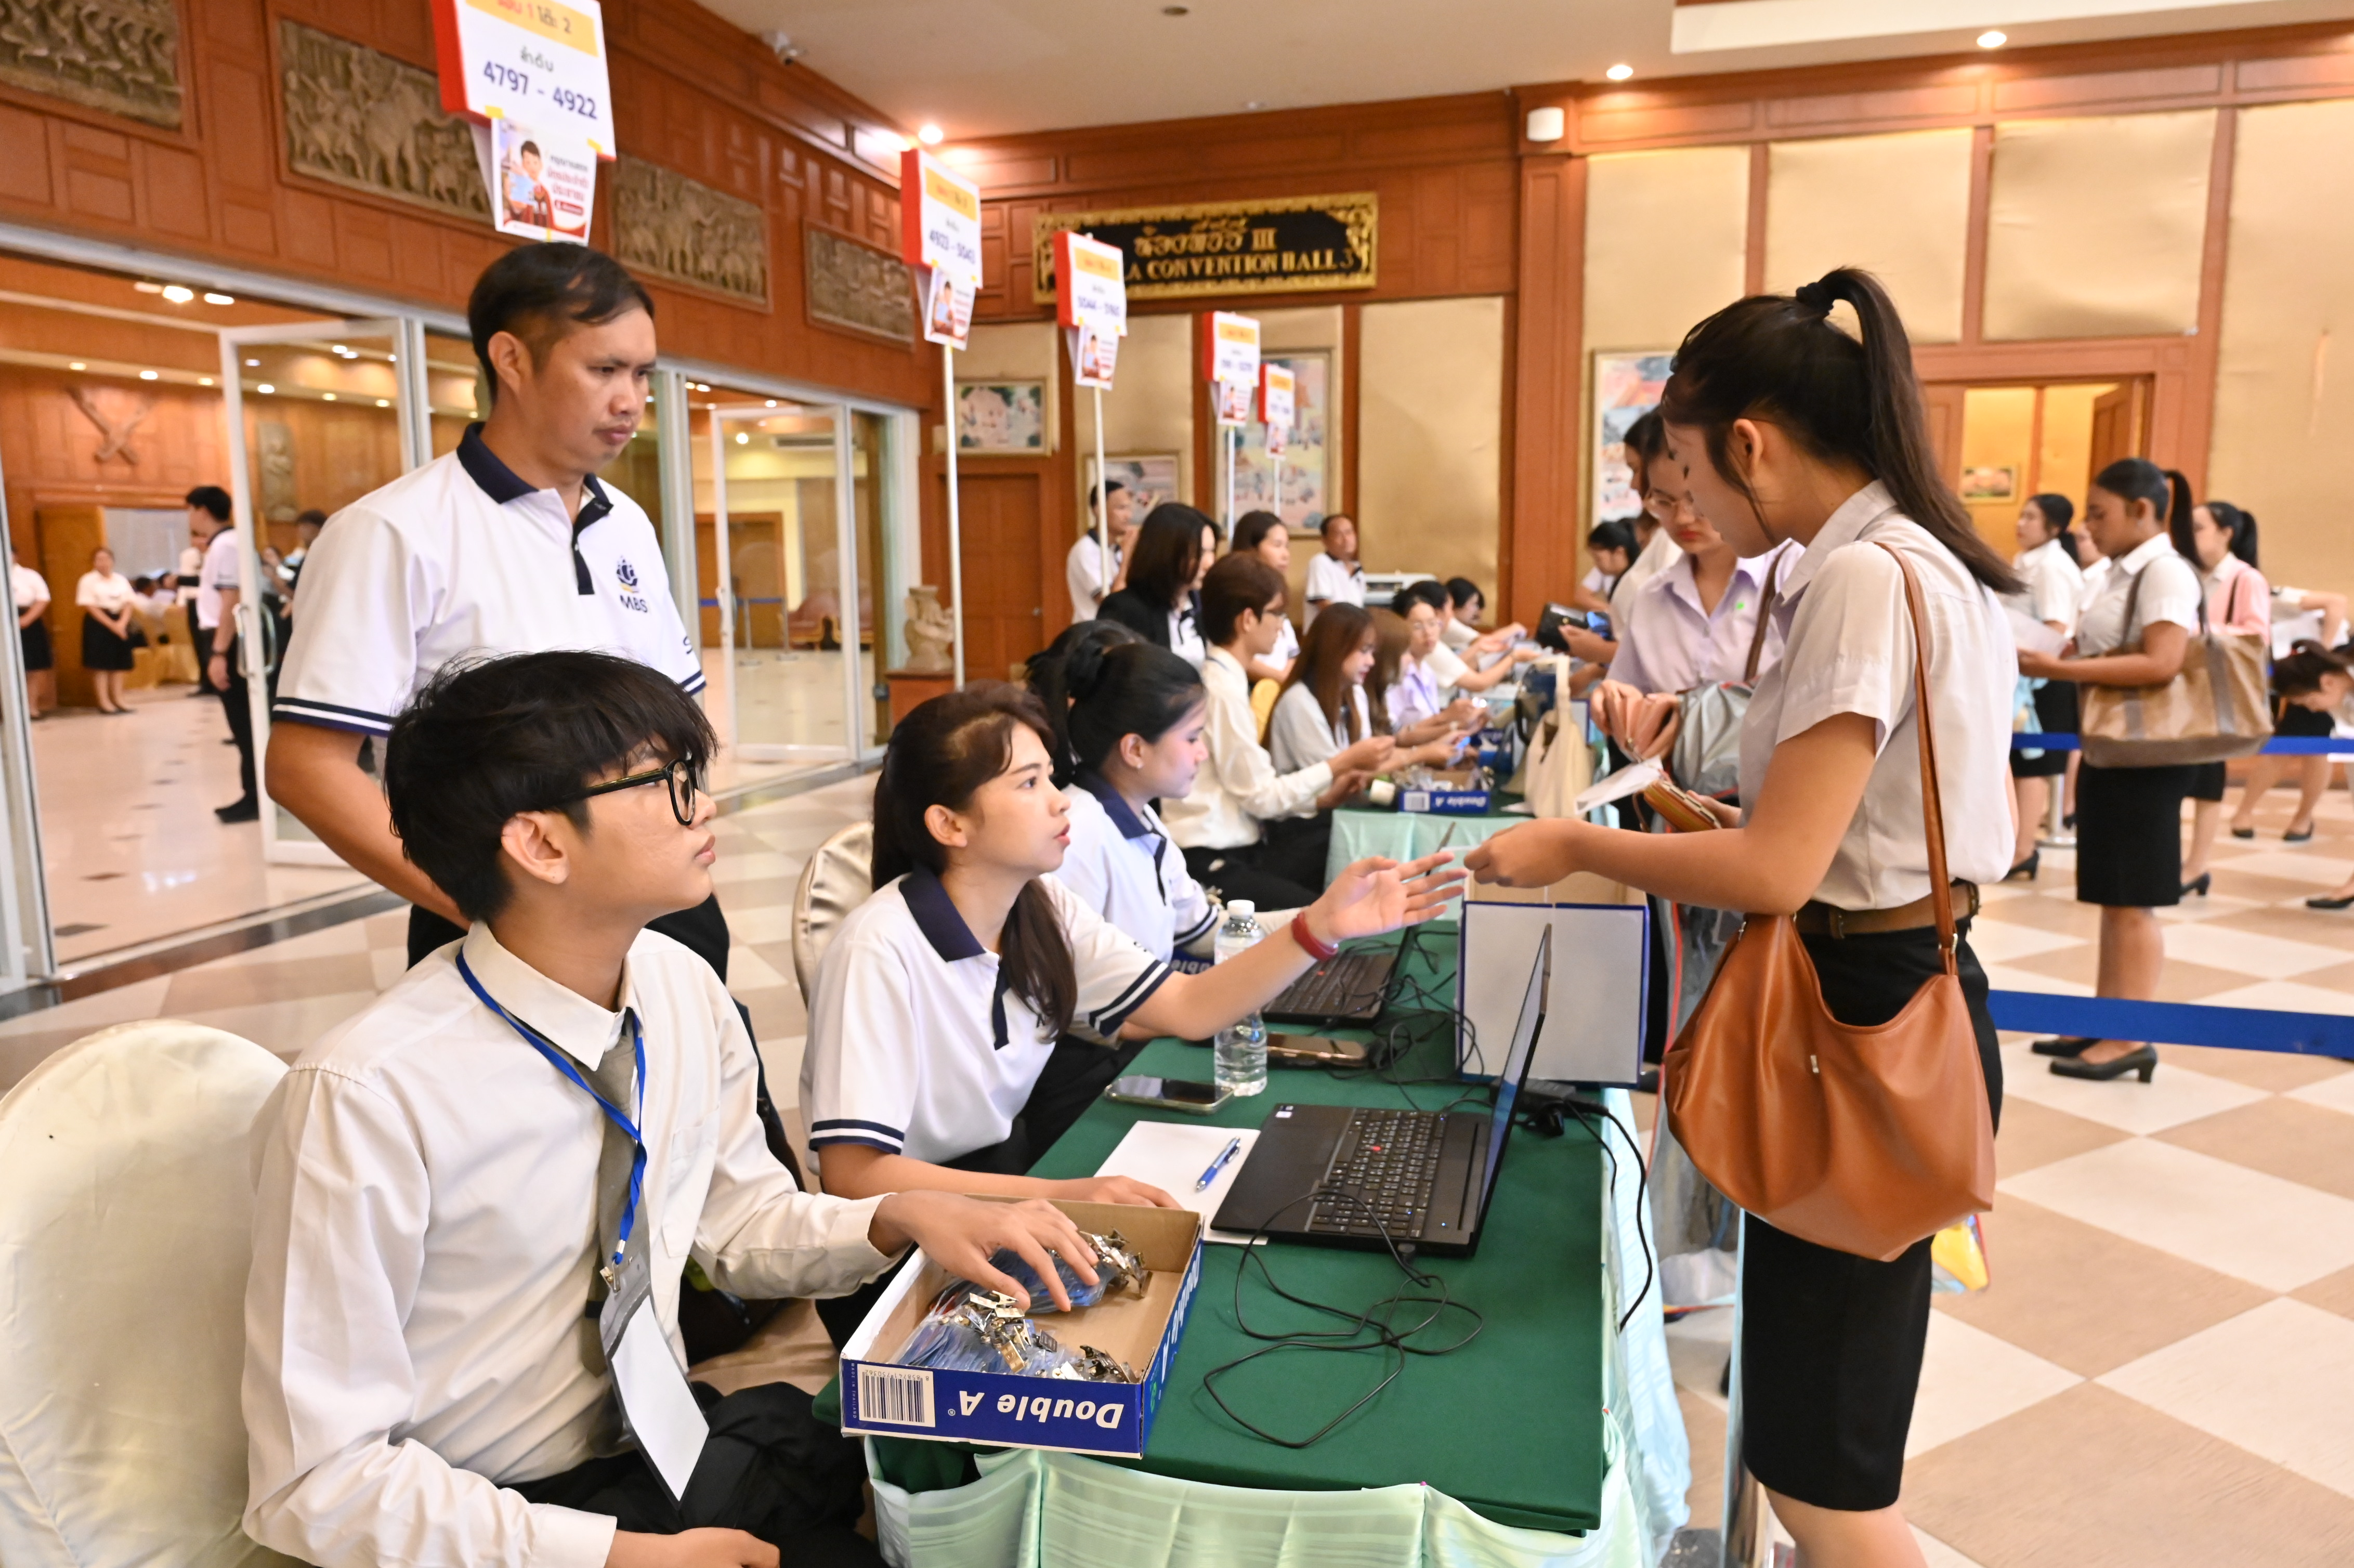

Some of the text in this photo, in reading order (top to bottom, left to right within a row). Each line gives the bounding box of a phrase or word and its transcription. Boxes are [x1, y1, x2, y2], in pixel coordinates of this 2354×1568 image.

[563, 17, 572, 33] 2
[484, 61, 528, 94] 4797
[553, 87, 597, 120] 4922
[1147, 253, 1278, 279] CONVENTION
[1283, 249, 1337, 270] HALL
[620, 595, 648, 613] MBS
[997, 1394, 1124, 1429] Double
